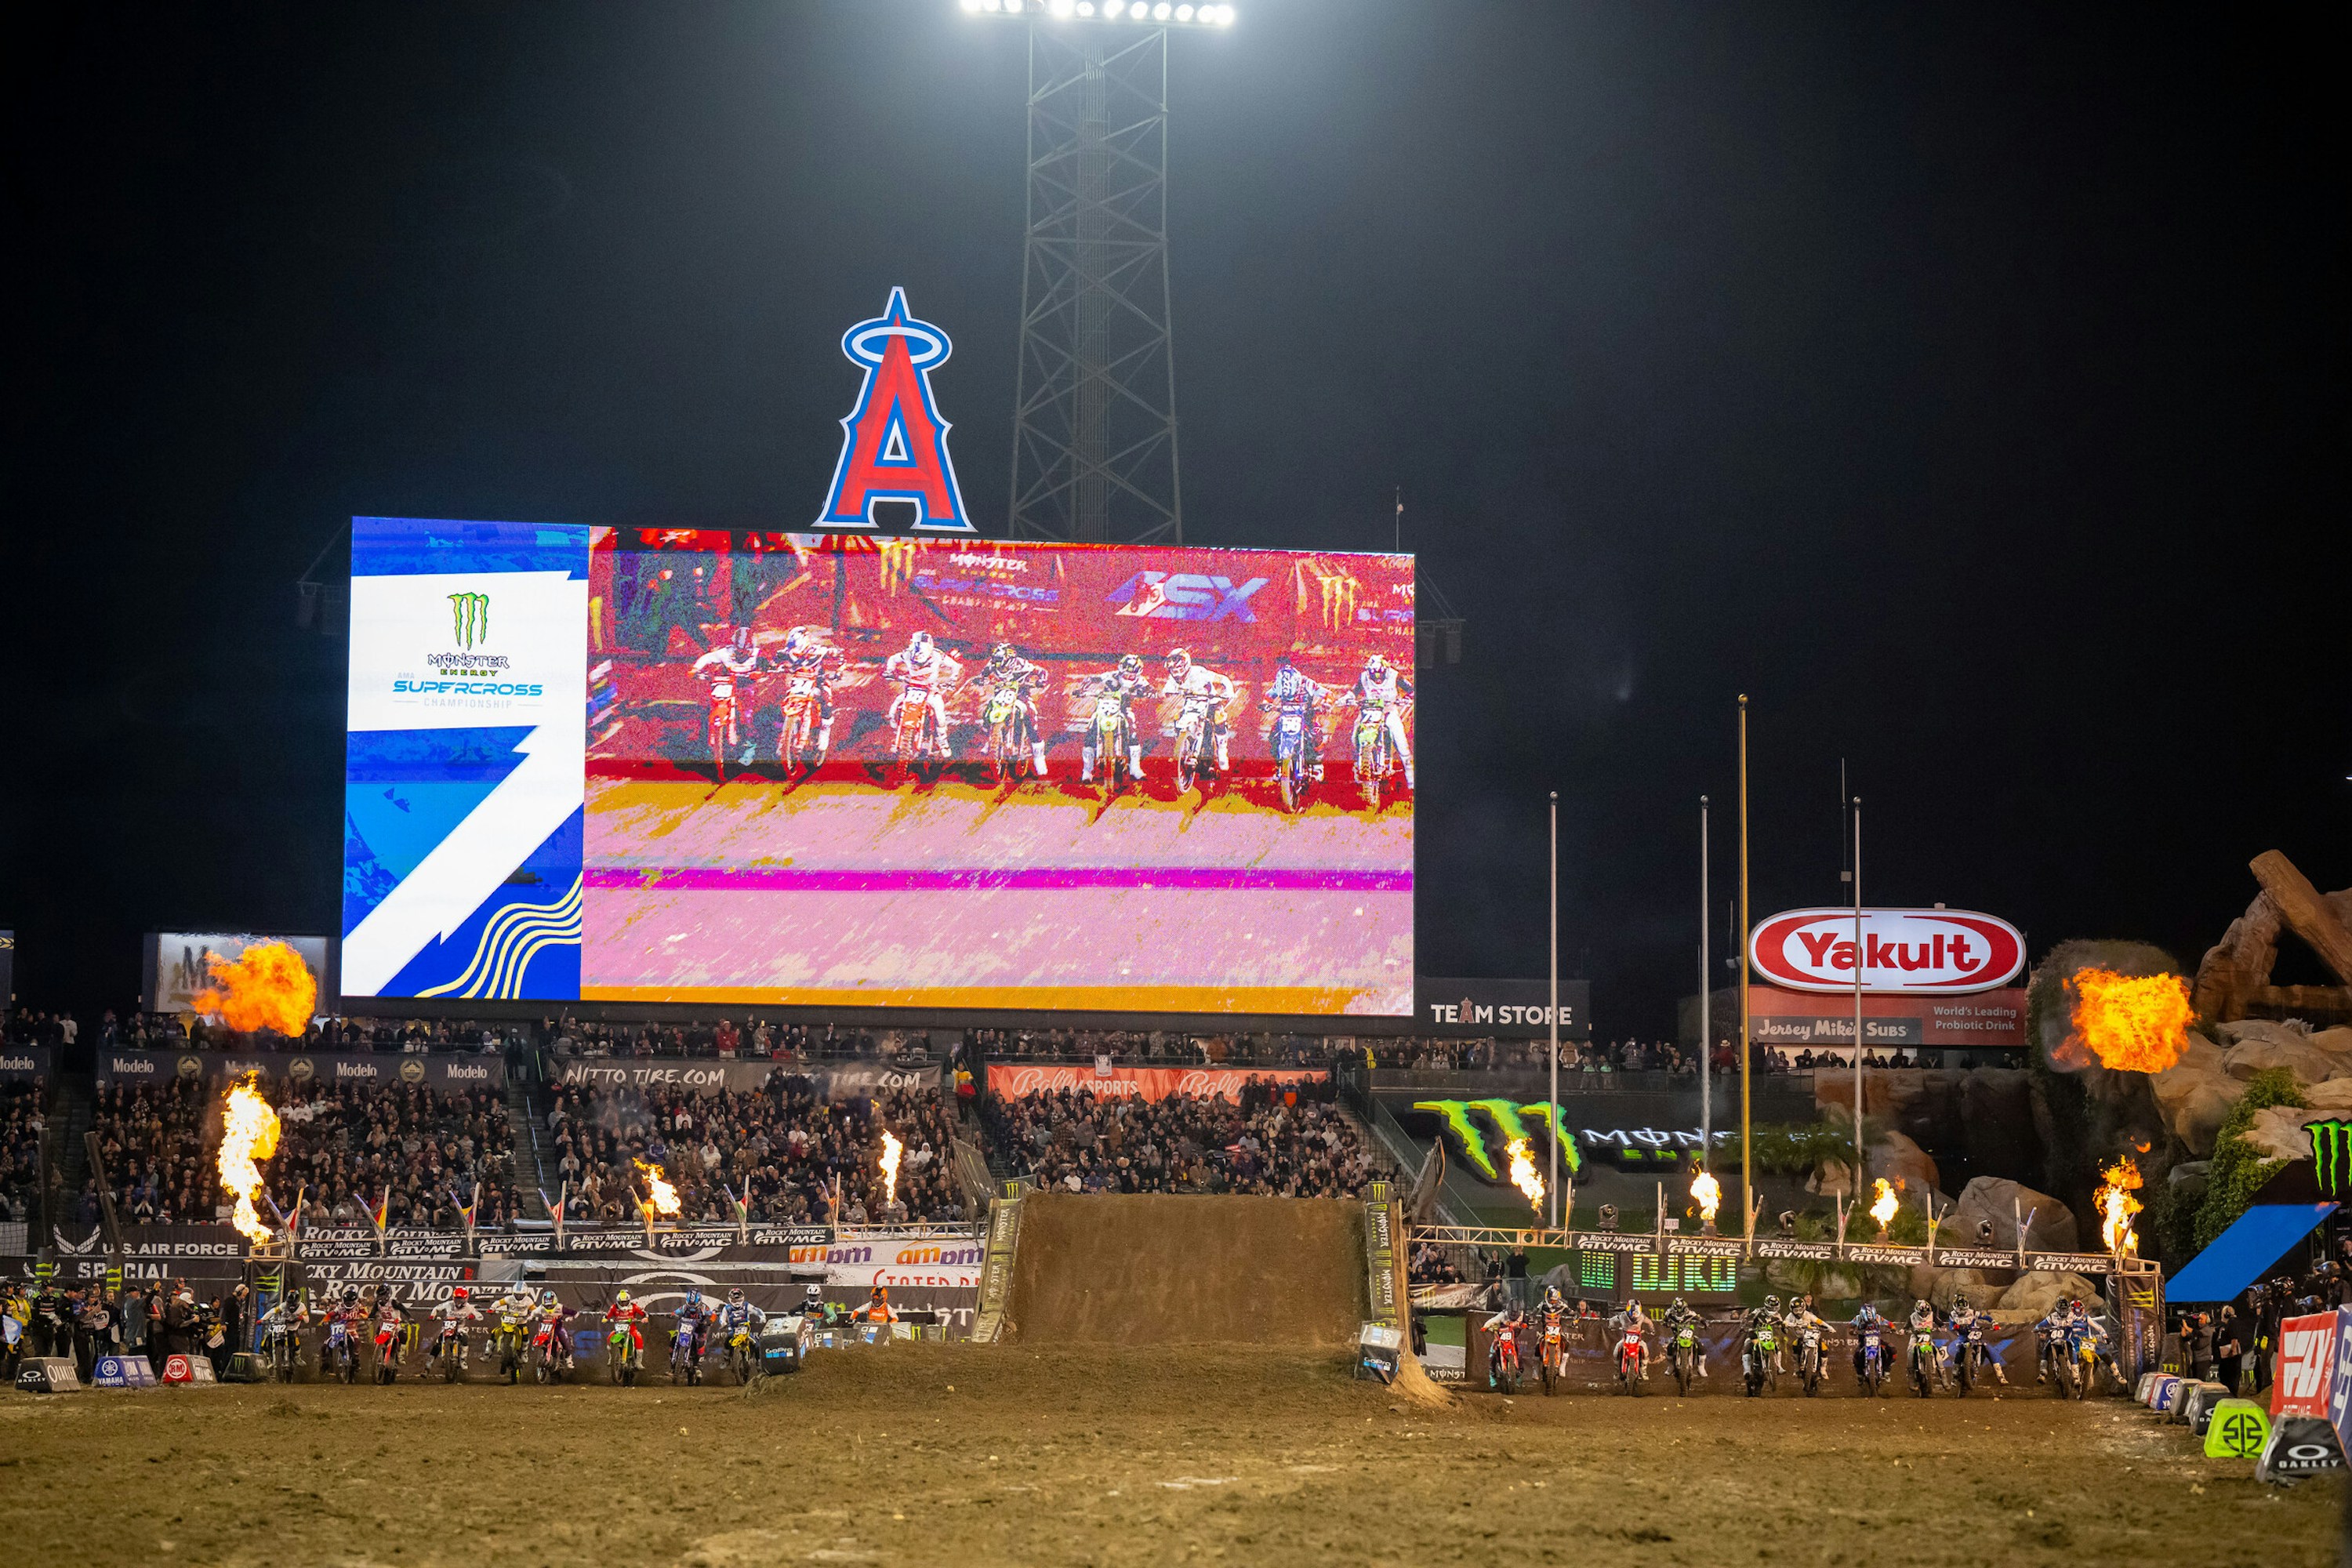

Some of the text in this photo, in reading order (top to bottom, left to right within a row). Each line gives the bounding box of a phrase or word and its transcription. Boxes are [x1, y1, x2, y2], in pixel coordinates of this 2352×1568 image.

[427, 653, 510, 668] MONSTER
[393, 681, 543, 696] SUPERCROSS
[423, 698, 513, 709] CHAMPIONSHIP
[1796, 931, 1981, 972] Yakult
[1431, 998, 1493, 1024] TEAM
[1933, 1006, 2016, 1019] World's Leading
[1759, 1019, 1811, 1040] Jersey
[1936, 1019, 2015, 1031] Probiotic Drink
[0, 1056, 35, 1070] odelo
[113, 1058, 154, 1073] Modelo
[336, 1062, 378, 1077] Modelo
[447, 1063, 488, 1079] Modelo
[565, 1064, 626, 1085] NITTO
[1011, 1068, 1139, 1098] Bally SPORTS
[1178, 1071, 1242, 1099] Ball
[996, 1208, 1010, 1242] MONSTER
[1377, 1212, 1388, 1247] MONSTER
[303, 1226, 370, 1240] ROCKY
[139, 1243, 170, 1255] AIR
[175, 1243, 238, 1255] FORCE
[1703, 1240, 1741, 1249] MOUNTAIN
[789, 1246, 873, 1264] ampm
[896, 1246, 985, 1265] ampm
[2045, 1254, 2107, 1265] ROCKY MOUNTAIN
[343, 1262, 463, 1280] MOUNTAIN
[322, 1279, 407, 1301] ROCY
[1383, 1269, 1393, 1305] MONSTER
[443, 1320, 456, 1330] 93
[1546, 1327, 1560, 1335] 34
[1625, 1334, 1639, 1344] 18
[1679, 1329, 1693, 1339] 48
[1759, 1331, 1773, 1341] 55
[1865, 1337, 1878, 1346] 56
[1968, 1331, 1982, 1341] 43
[98, 1377, 124, 1385] YAMAHA
[2278, 1459, 2339, 1469] OAKLEY
